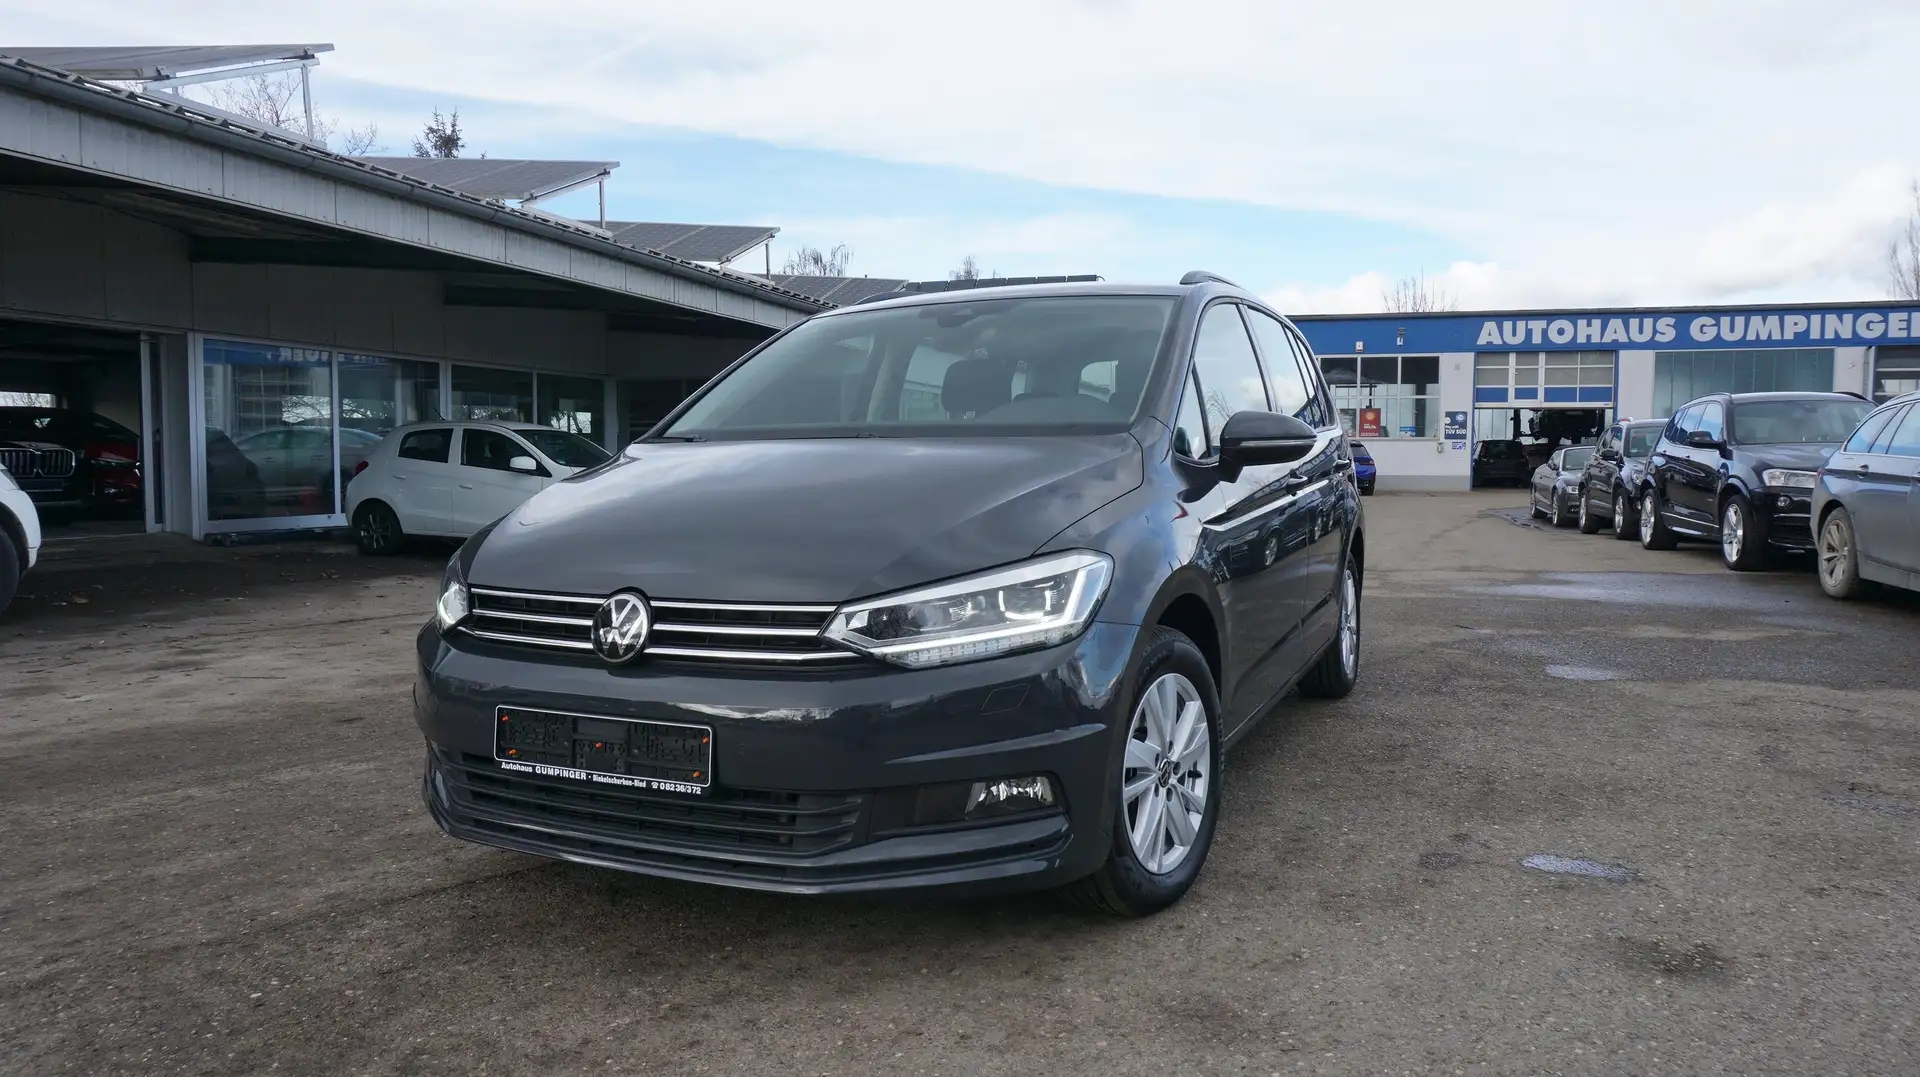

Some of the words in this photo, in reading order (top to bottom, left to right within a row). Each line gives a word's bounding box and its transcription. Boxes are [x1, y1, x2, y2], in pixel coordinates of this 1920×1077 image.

[1476, 317, 1676, 345] AUTOHAUS
[501, 761, 533, 773] Autohaus
[535, 765, 587, 781] GUMPINGER
